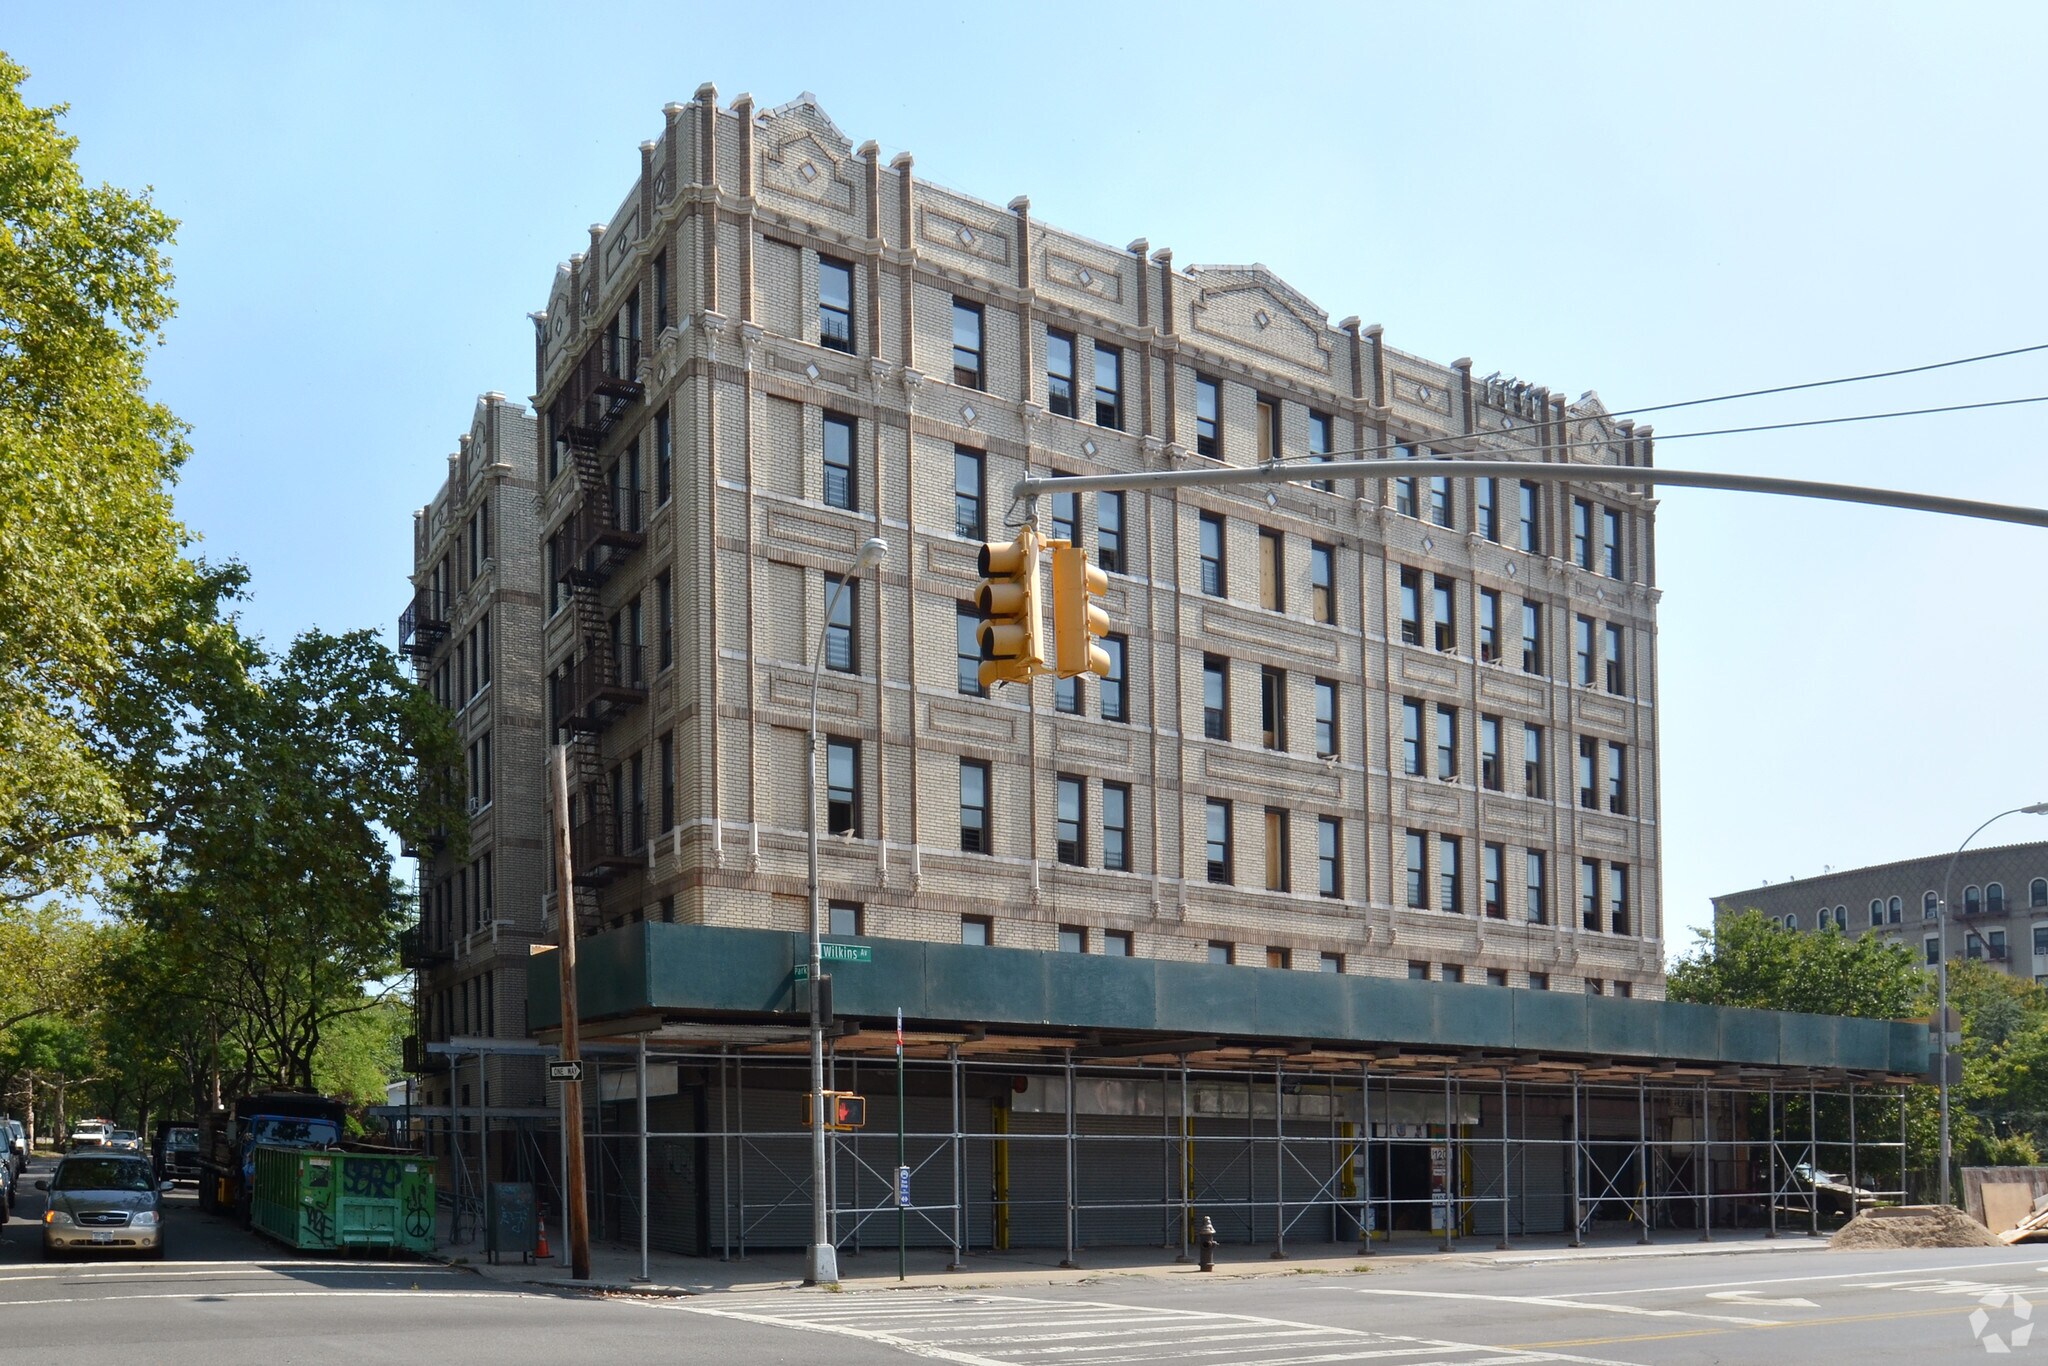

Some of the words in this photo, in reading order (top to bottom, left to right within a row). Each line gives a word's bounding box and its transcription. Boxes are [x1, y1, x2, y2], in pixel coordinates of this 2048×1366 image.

[823, 946, 857, 959] Wilkins
[794, 966, 808, 975] Park
[553, 1067, 564, 1076] ONE
[567, 1067, 577, 1075] WAY
